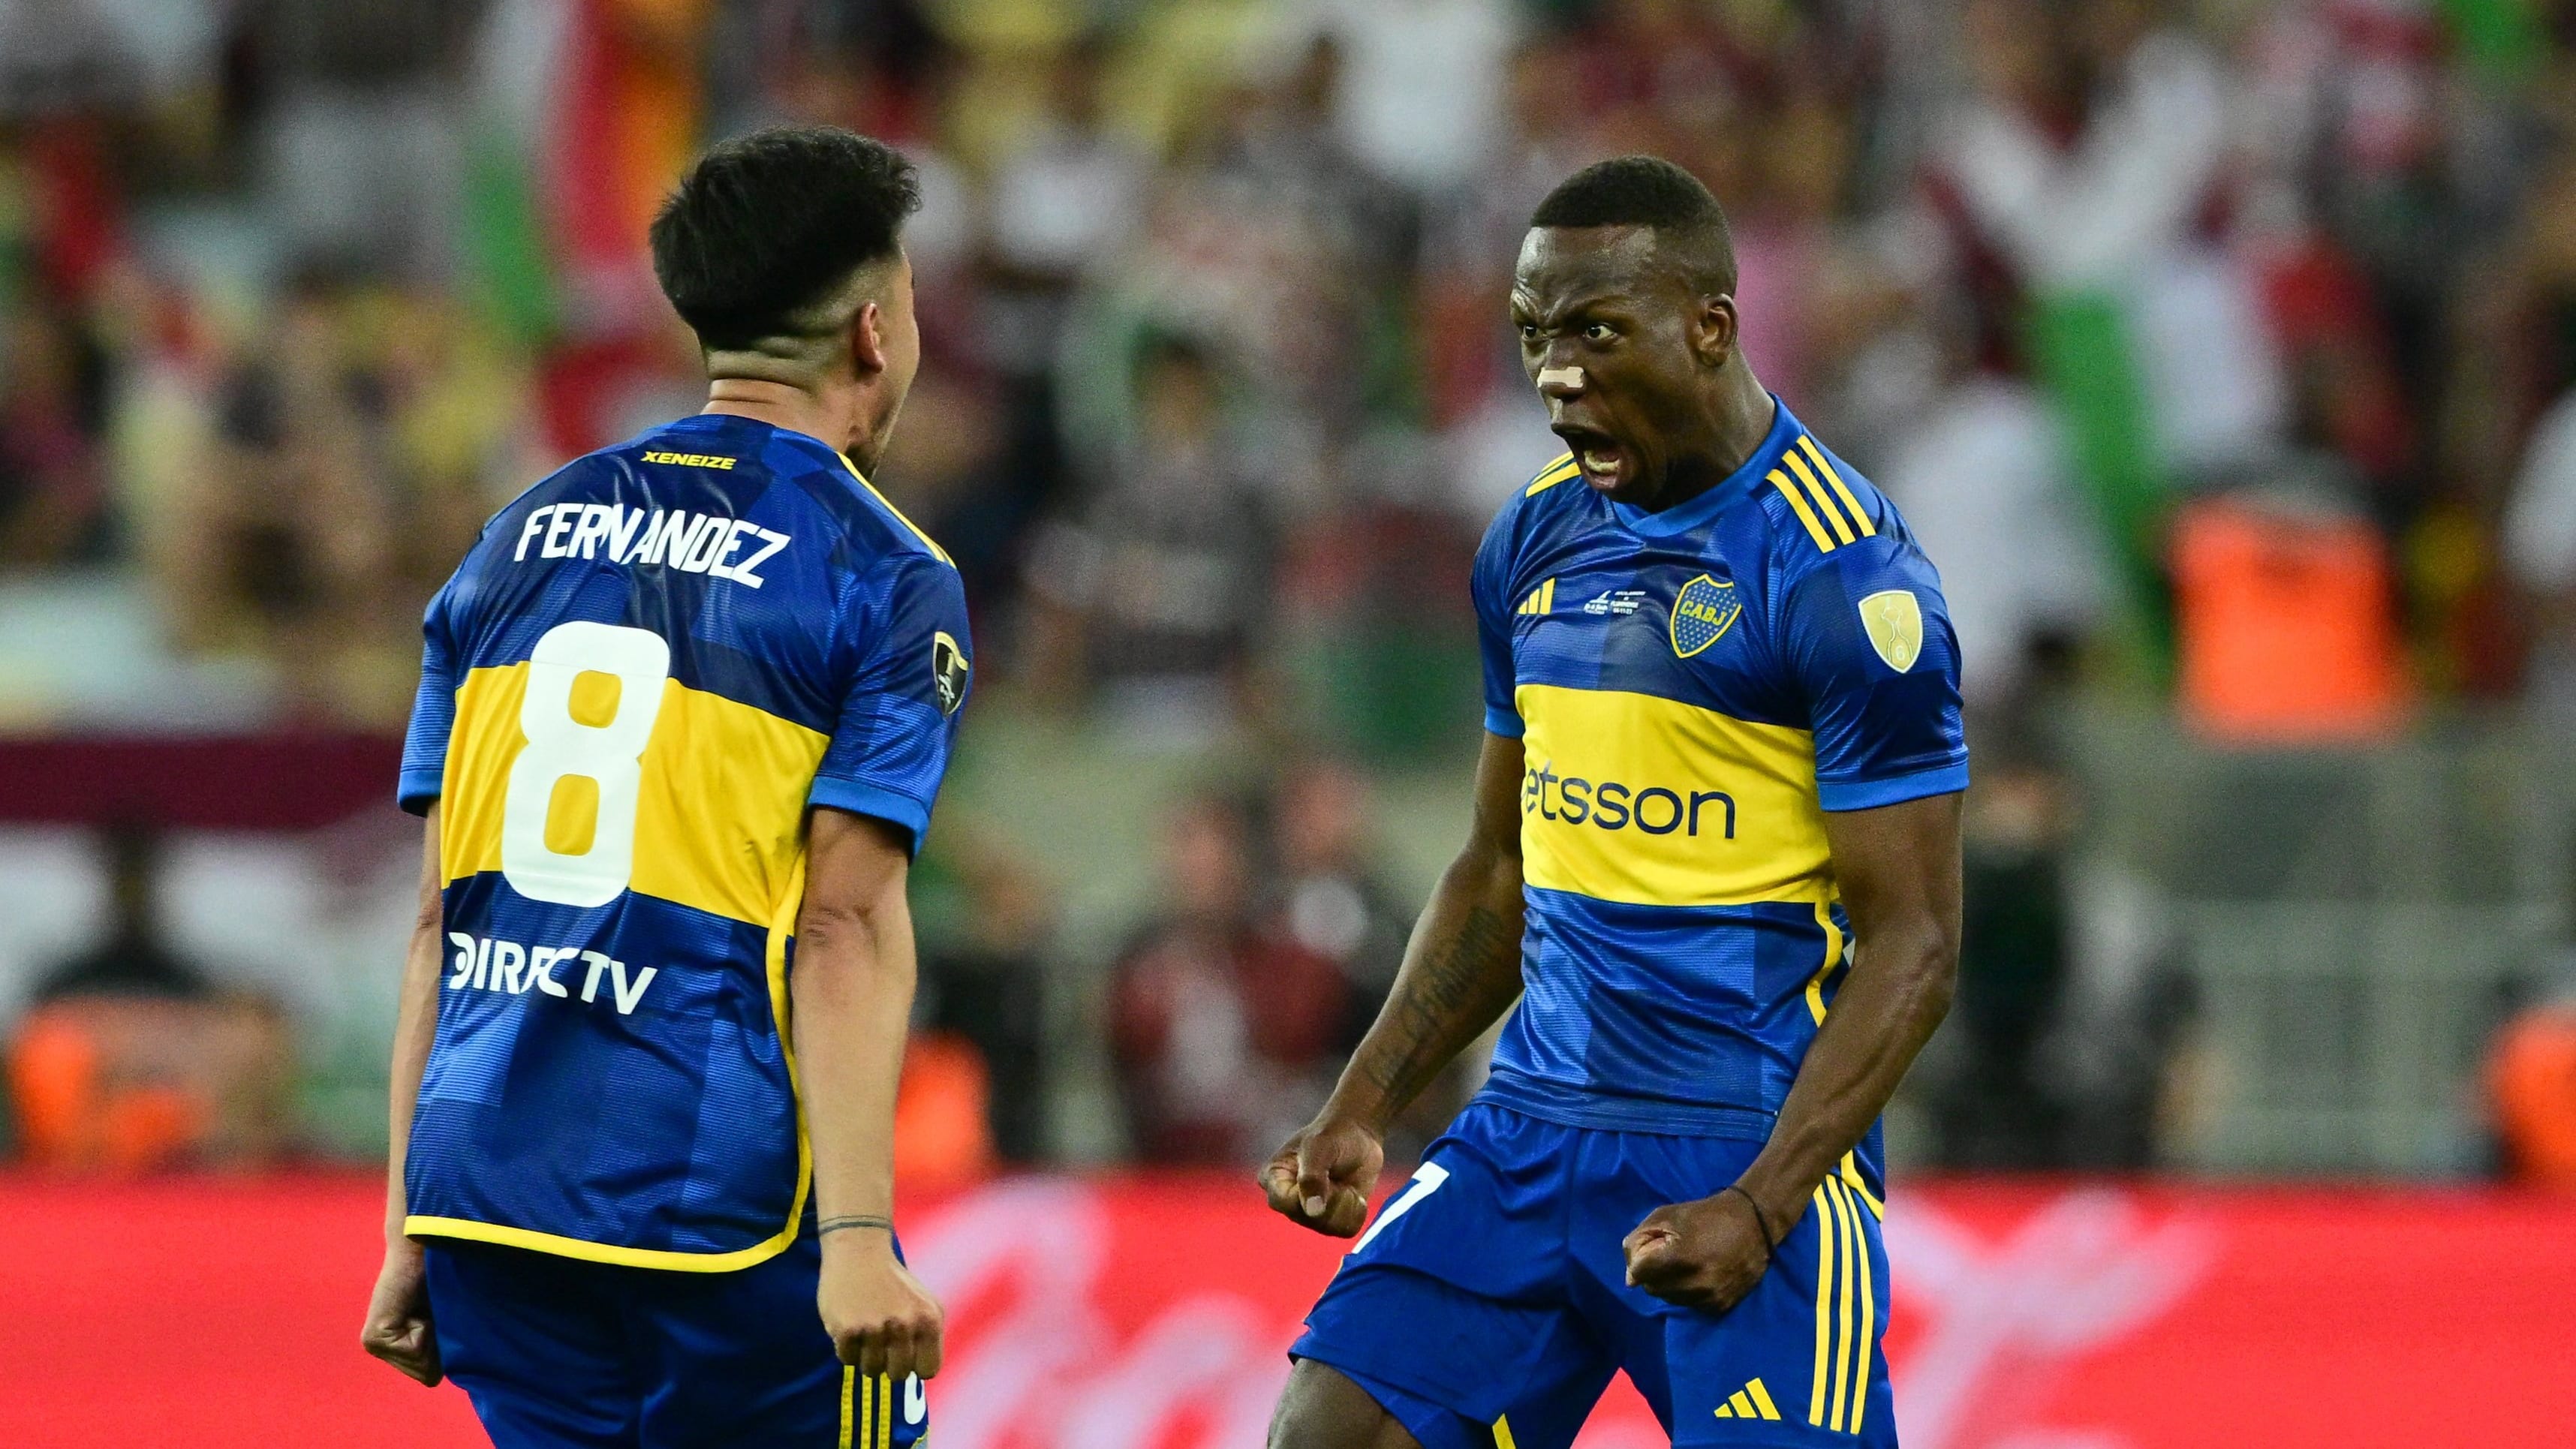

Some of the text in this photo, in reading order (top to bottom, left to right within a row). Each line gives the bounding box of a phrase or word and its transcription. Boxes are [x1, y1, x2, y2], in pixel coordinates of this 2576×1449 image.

[640, 451, 737, 470] XENEIZE
[515, 504, 790, 588] FERNANDEZ
[1681, 600, 1727, 626] CABJ
[501, 621, 670, 908] 8
[1522, 759, 1735, 839] etsson
[448, 932, 658, 1015] DIRECTV
